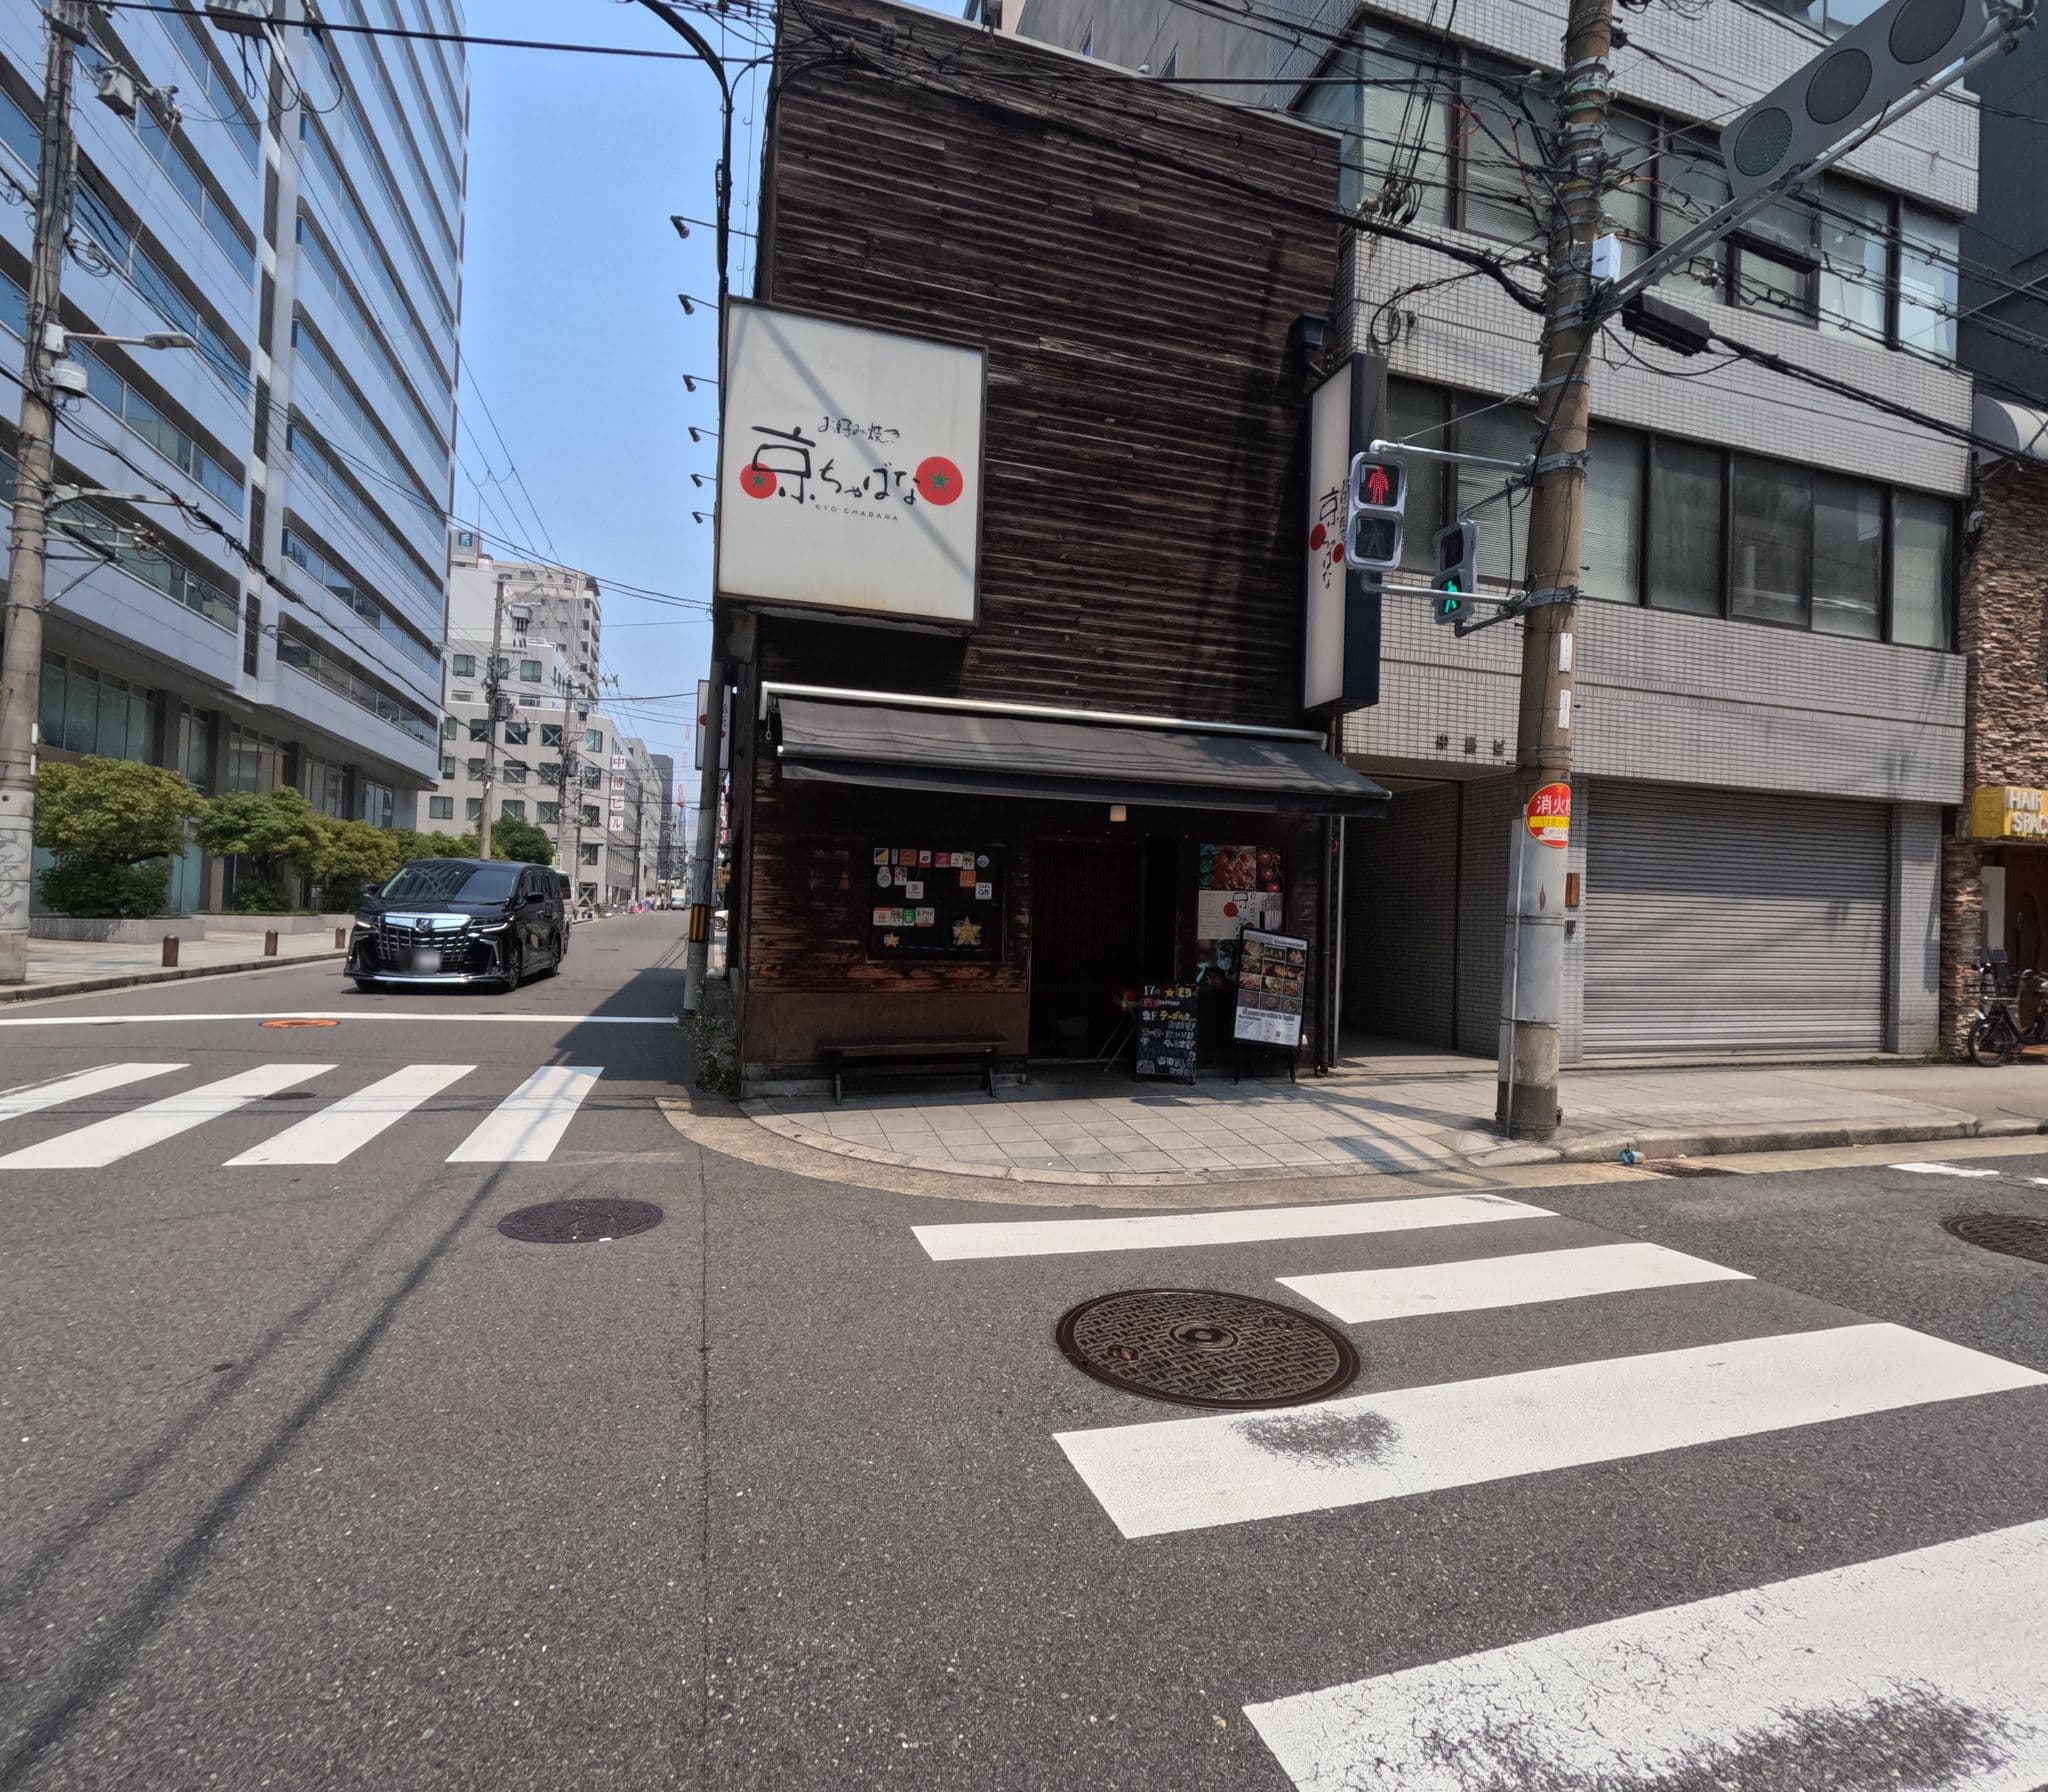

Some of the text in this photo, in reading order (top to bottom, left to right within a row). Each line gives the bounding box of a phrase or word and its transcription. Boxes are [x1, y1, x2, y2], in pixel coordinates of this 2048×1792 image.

[818, 416, 900, 444] お好み焼き
[751, 426, 921, 505] 京ちゃばな
[2005, 789, 2042, 811] HAIR
